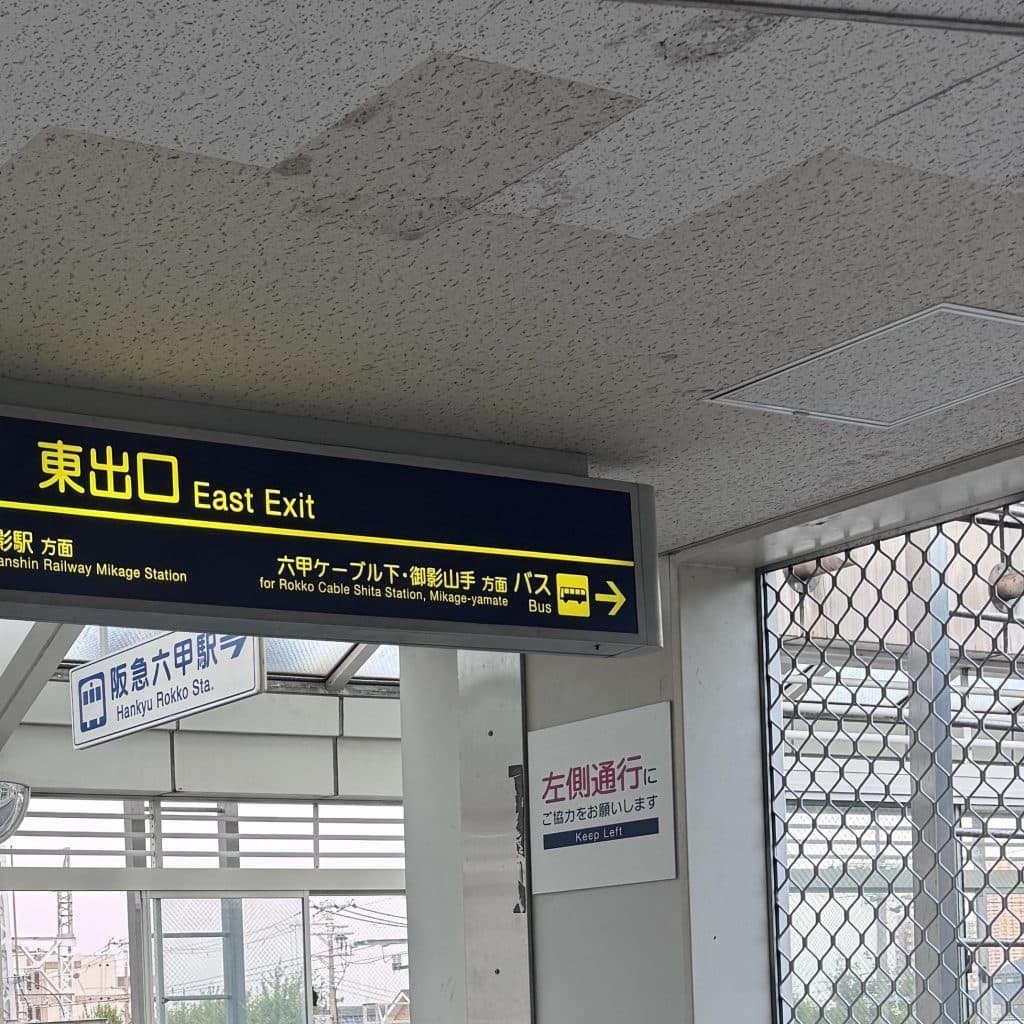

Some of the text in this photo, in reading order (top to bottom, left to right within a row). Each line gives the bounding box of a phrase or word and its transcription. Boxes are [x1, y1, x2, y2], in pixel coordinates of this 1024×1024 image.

[38, 440, 180, 503] 東出口
[193, 481, 316, 520] East Exit
[41, 537, 73, 558] 方面
[43, 558, 92, 577] Railway
[96, 563, 140, 581] Mikage
[144, 566, 187, 583] Station
[277, 555, 552, 596] 六甲ケーブル下・御影山手 方面 バス
[259, 576, 509, 606] for Rokko Cable Shita Station, Mikage-yamate
[528, 599, 552, 614] Bus
[110, 632, 218, 700] 阪急六甲駅
[116, 679, 215, 721] Hankyu Rokko Sta.
[542, 755, 658, 804] 左側通行に
[542, 794, 659, 826] ご協力をお願いします
[576, 826, 623, 842] Keep Left
